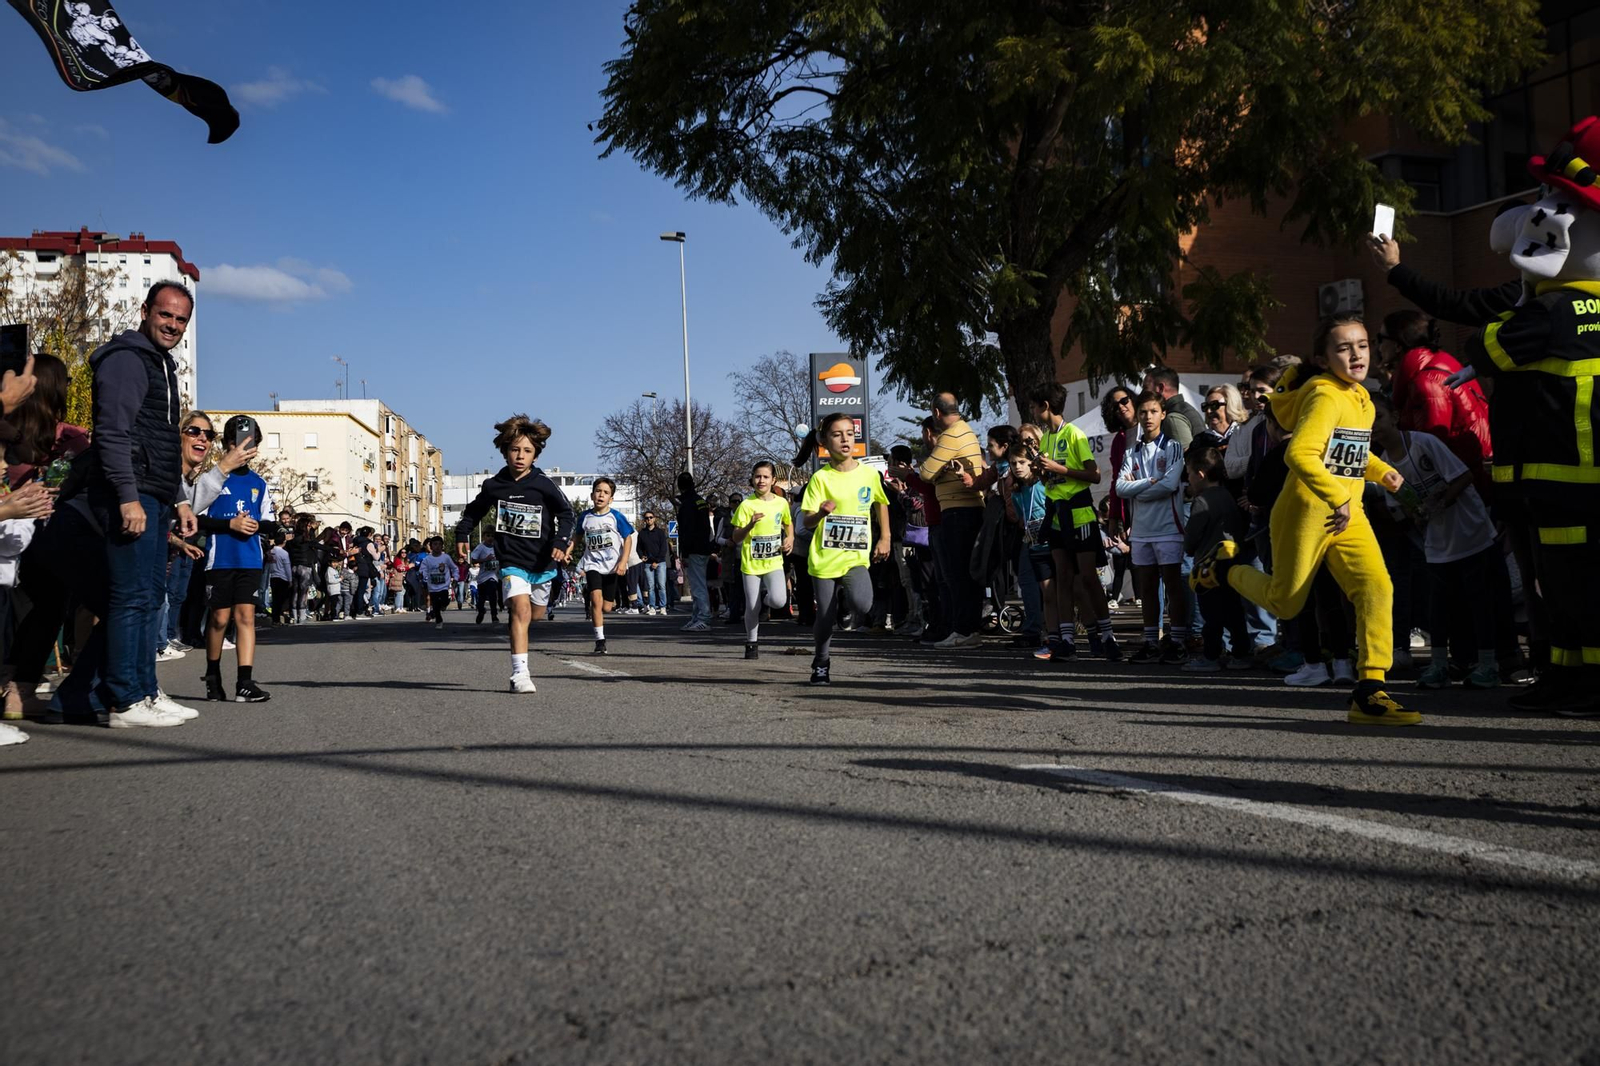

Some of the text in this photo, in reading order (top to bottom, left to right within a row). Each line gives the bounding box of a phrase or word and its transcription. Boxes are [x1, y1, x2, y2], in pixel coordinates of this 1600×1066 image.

[818, 397, 862, 406] REPSOL
[1330, 442, 1364, 467] 464
[502, 511, 525, 529] 472
[829, 525, 854, 541] 477
[754, 542, 772, 554] 478
